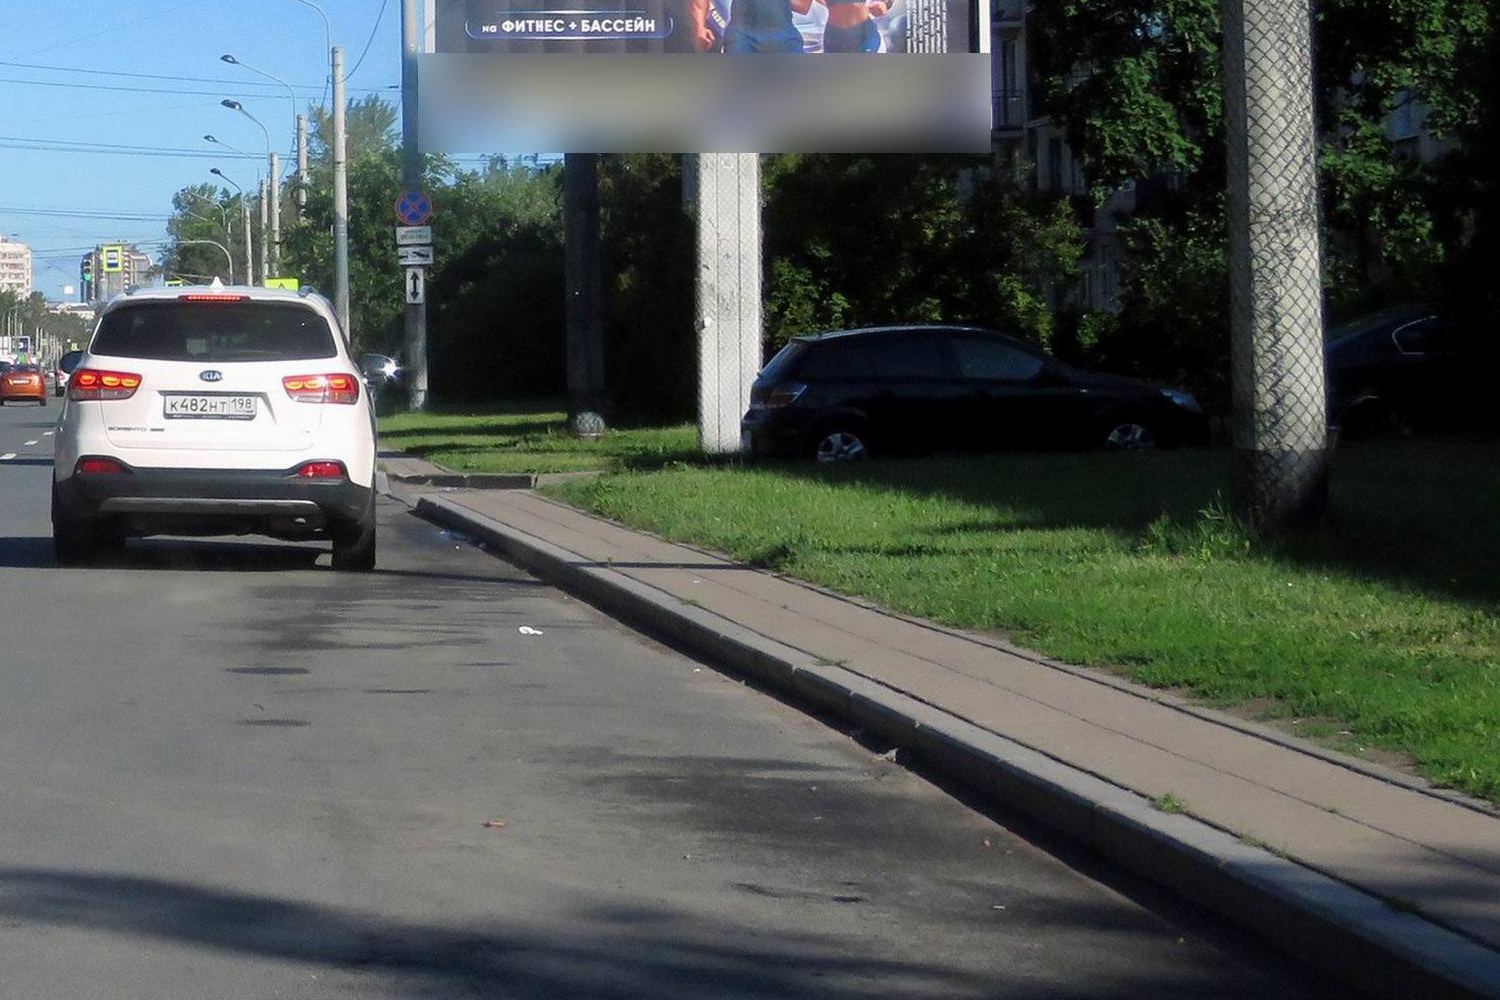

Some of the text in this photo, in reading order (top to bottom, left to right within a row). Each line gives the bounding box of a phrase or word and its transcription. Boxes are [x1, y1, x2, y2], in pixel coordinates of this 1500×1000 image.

[501, 19, 565, 33] ФИТНЕС
[580, 17, 656, 33] БАССЕЙН
[230, 398, 251, 409] 198
